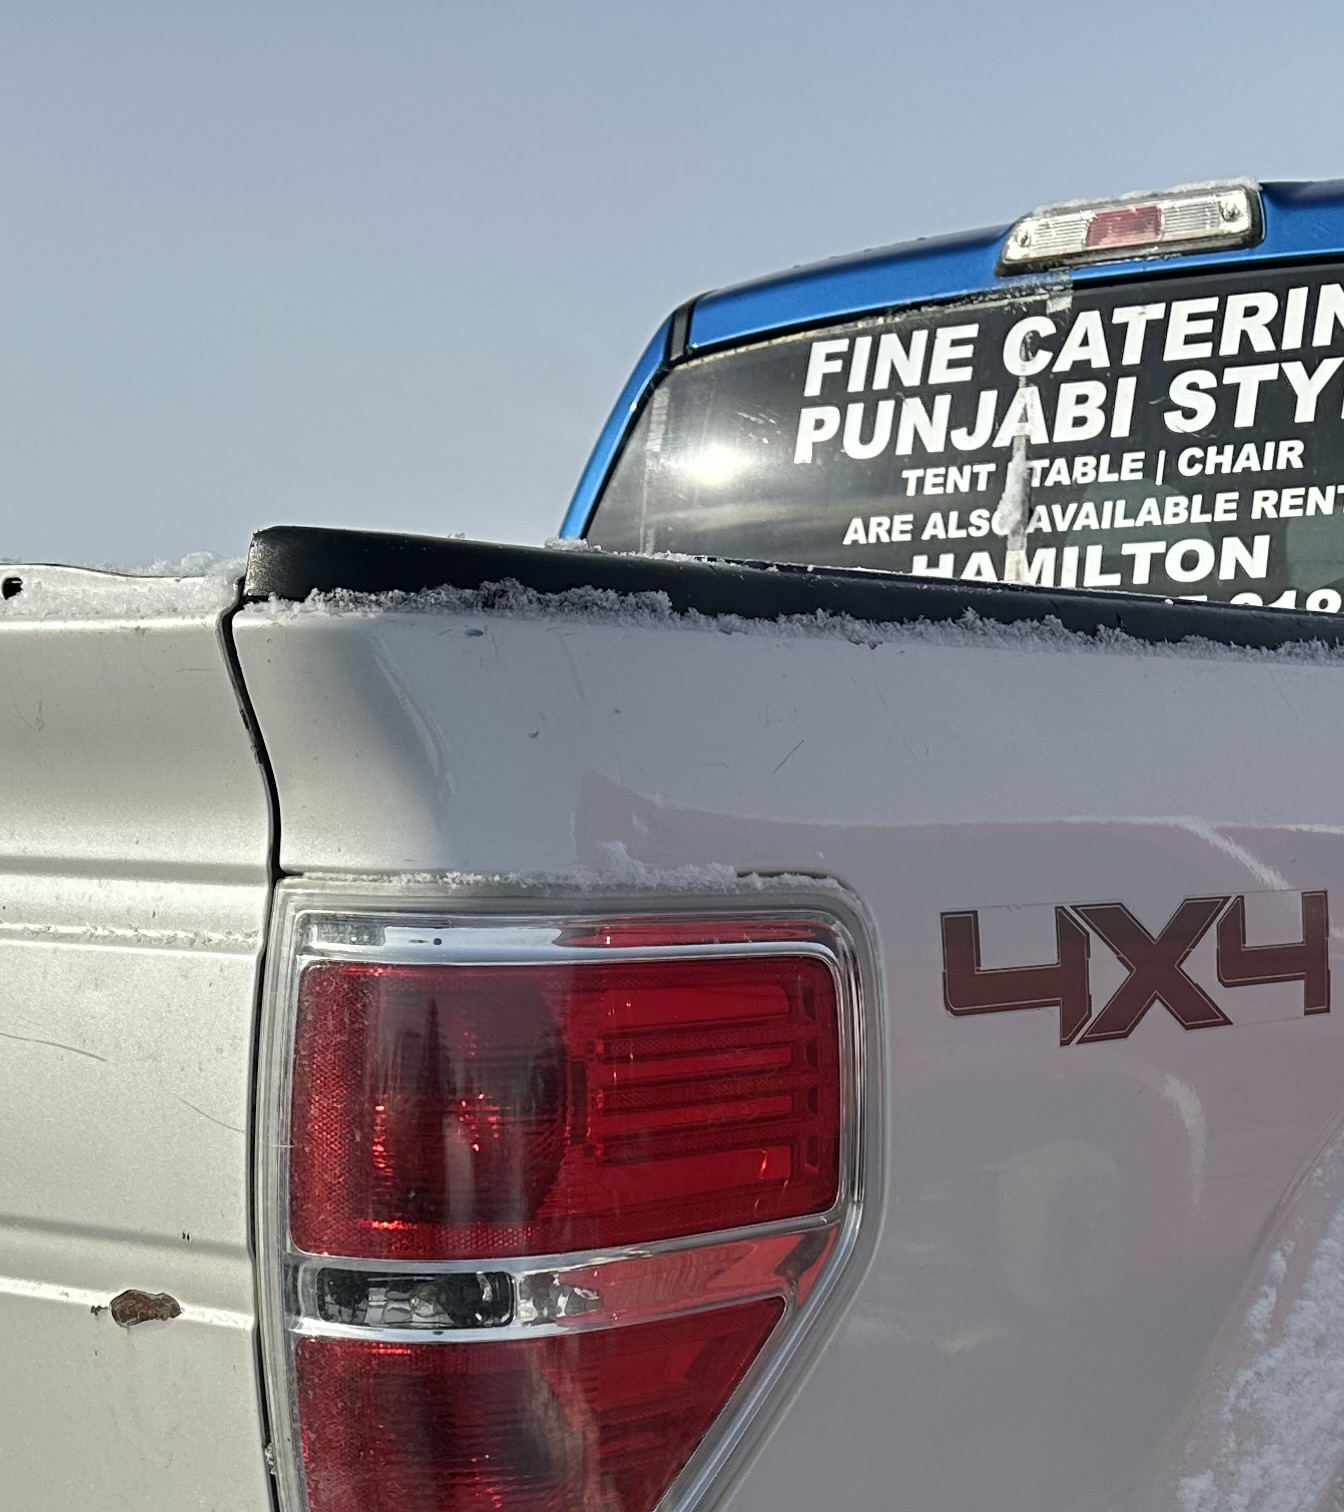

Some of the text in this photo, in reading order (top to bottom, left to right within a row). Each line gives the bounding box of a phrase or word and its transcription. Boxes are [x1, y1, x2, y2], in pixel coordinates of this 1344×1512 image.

[803, 323, 979, 397] FINE
[793, 376, 1137, 463] PUNJABI
[902, 463, 997, 496] TENT
[1026, 451, 1145, 488] TABLE
[1177, 440, 1305, 477] CHAIR
[842, 513, 914, 545] ARE
[1026, 491, 1240, 533] AVAILABLE
[912, 534, 1271, 588] HAMILTON
